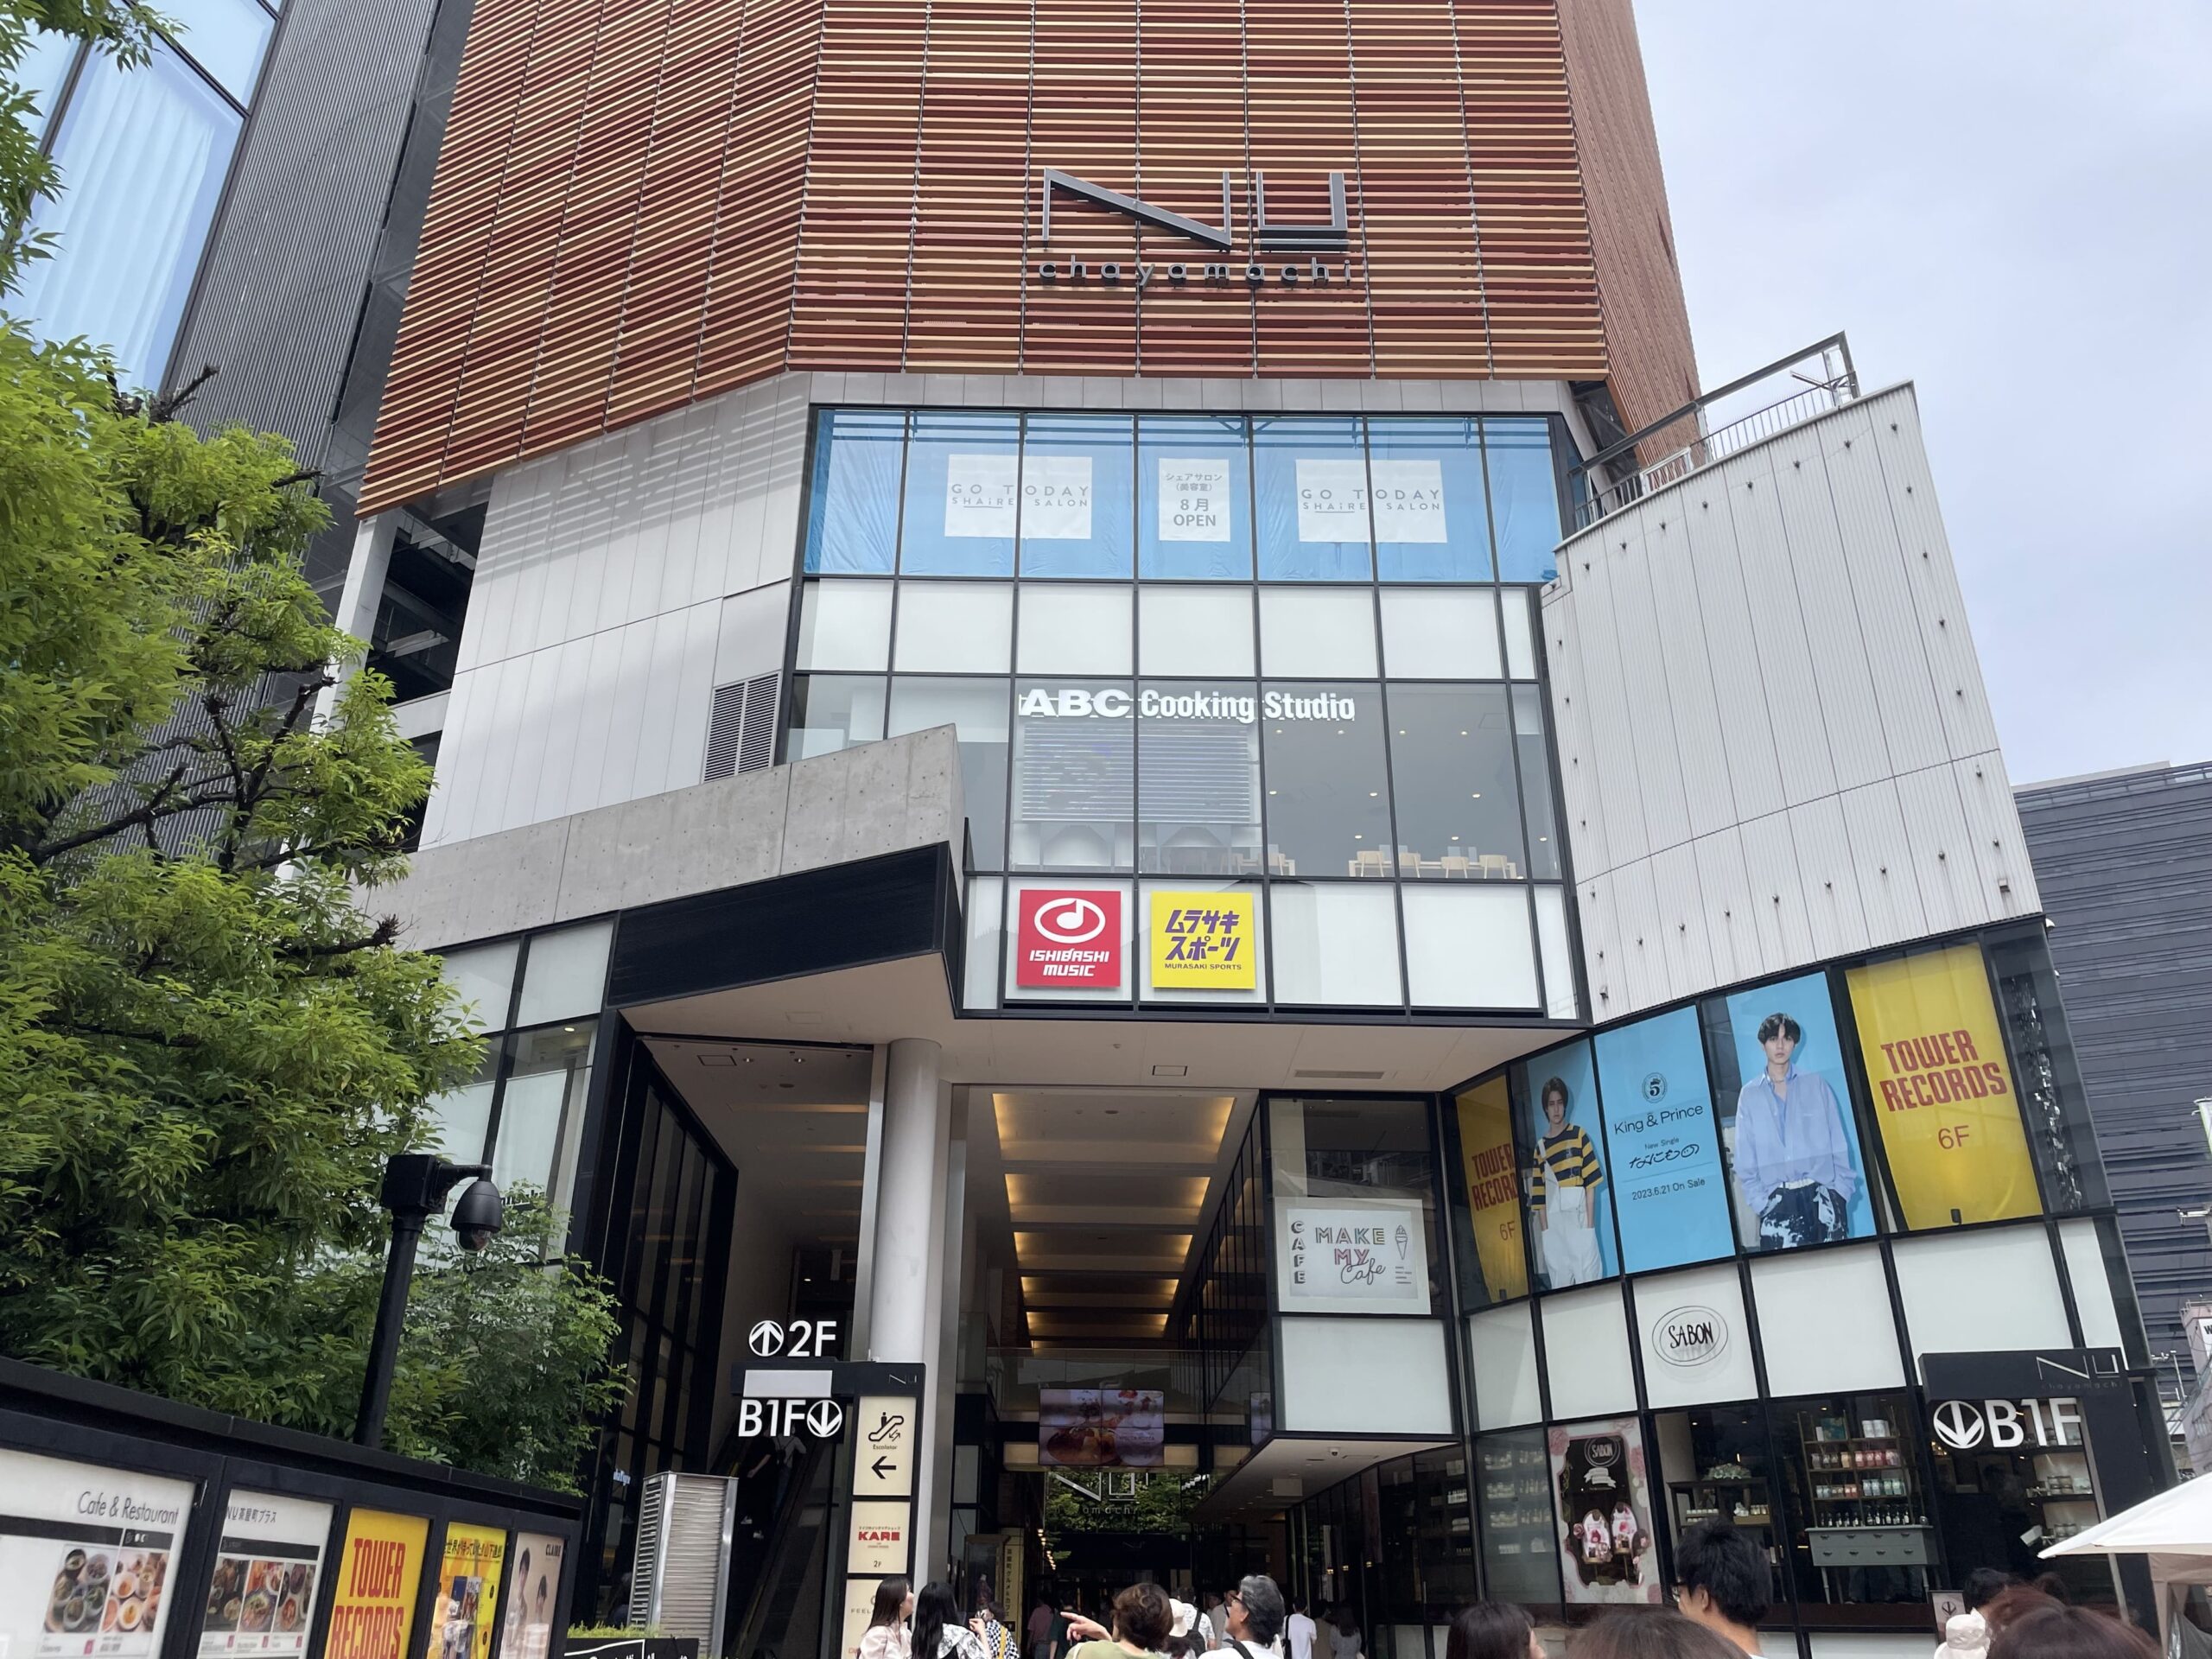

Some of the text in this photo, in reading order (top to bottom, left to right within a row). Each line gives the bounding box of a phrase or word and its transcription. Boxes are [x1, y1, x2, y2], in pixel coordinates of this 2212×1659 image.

[1039, 255, 1351, 286] chayamachi
[1165, 473, 1223, 481] シェアサロン
[951, 484, 1088, 496] GO TODAY
[1301, 489, 1440, 500] GO TODAY
[1034, 499, 1088, 507] SALON
[1173, 514, 1216, 526] OPEN
[1020, 689, 1356, 724] ABC Cooking Studio
[1165, 910, 1240, 934] ムラサキ
[1029, 948, 1109, 963] ISHIBASHI
[1165, 936, 1241, 961] スポーツ
[1043, 964, 1096, 977] MUSIC
[1880, 1029, 1979, 1075] TOWER
[1879, 1062, 2008, 1112] RECORDS
[1614, 1105, 1704, 1135] King & Prince
[1661, 1137, 1680, 1147] Single
[1937, 1125, 1971, 1150] 6F
[1471, 1143, 1516, 1180] TOWER
[1631, 1177, 1706, 1201] 2023.6.21 On Sale
[1315, 1227, 1385, 1244] MAKE
[1499, 1220, 1516, 1241] 6F
[1291, 1221, 1306, 1284] CAFE
[1334, 1249, 1370, 1265] MY
[1341, 1258, 1386, 1285] Cafe
[787, 1320, 836, 1357] 2F
[1668, 1321, 1713, 1348] SABON
[738, 1399, 806, 1437] B1F
[1985, 1397, 2082, 1447] B1F
[78, 1491, 179, 1525] Cafe & Restaurant
[858, 1531, 900, 1541] KARE
[349, 1538, 406, 1599] TOWER
[329, 1605, 404, 1659] RECORDS
